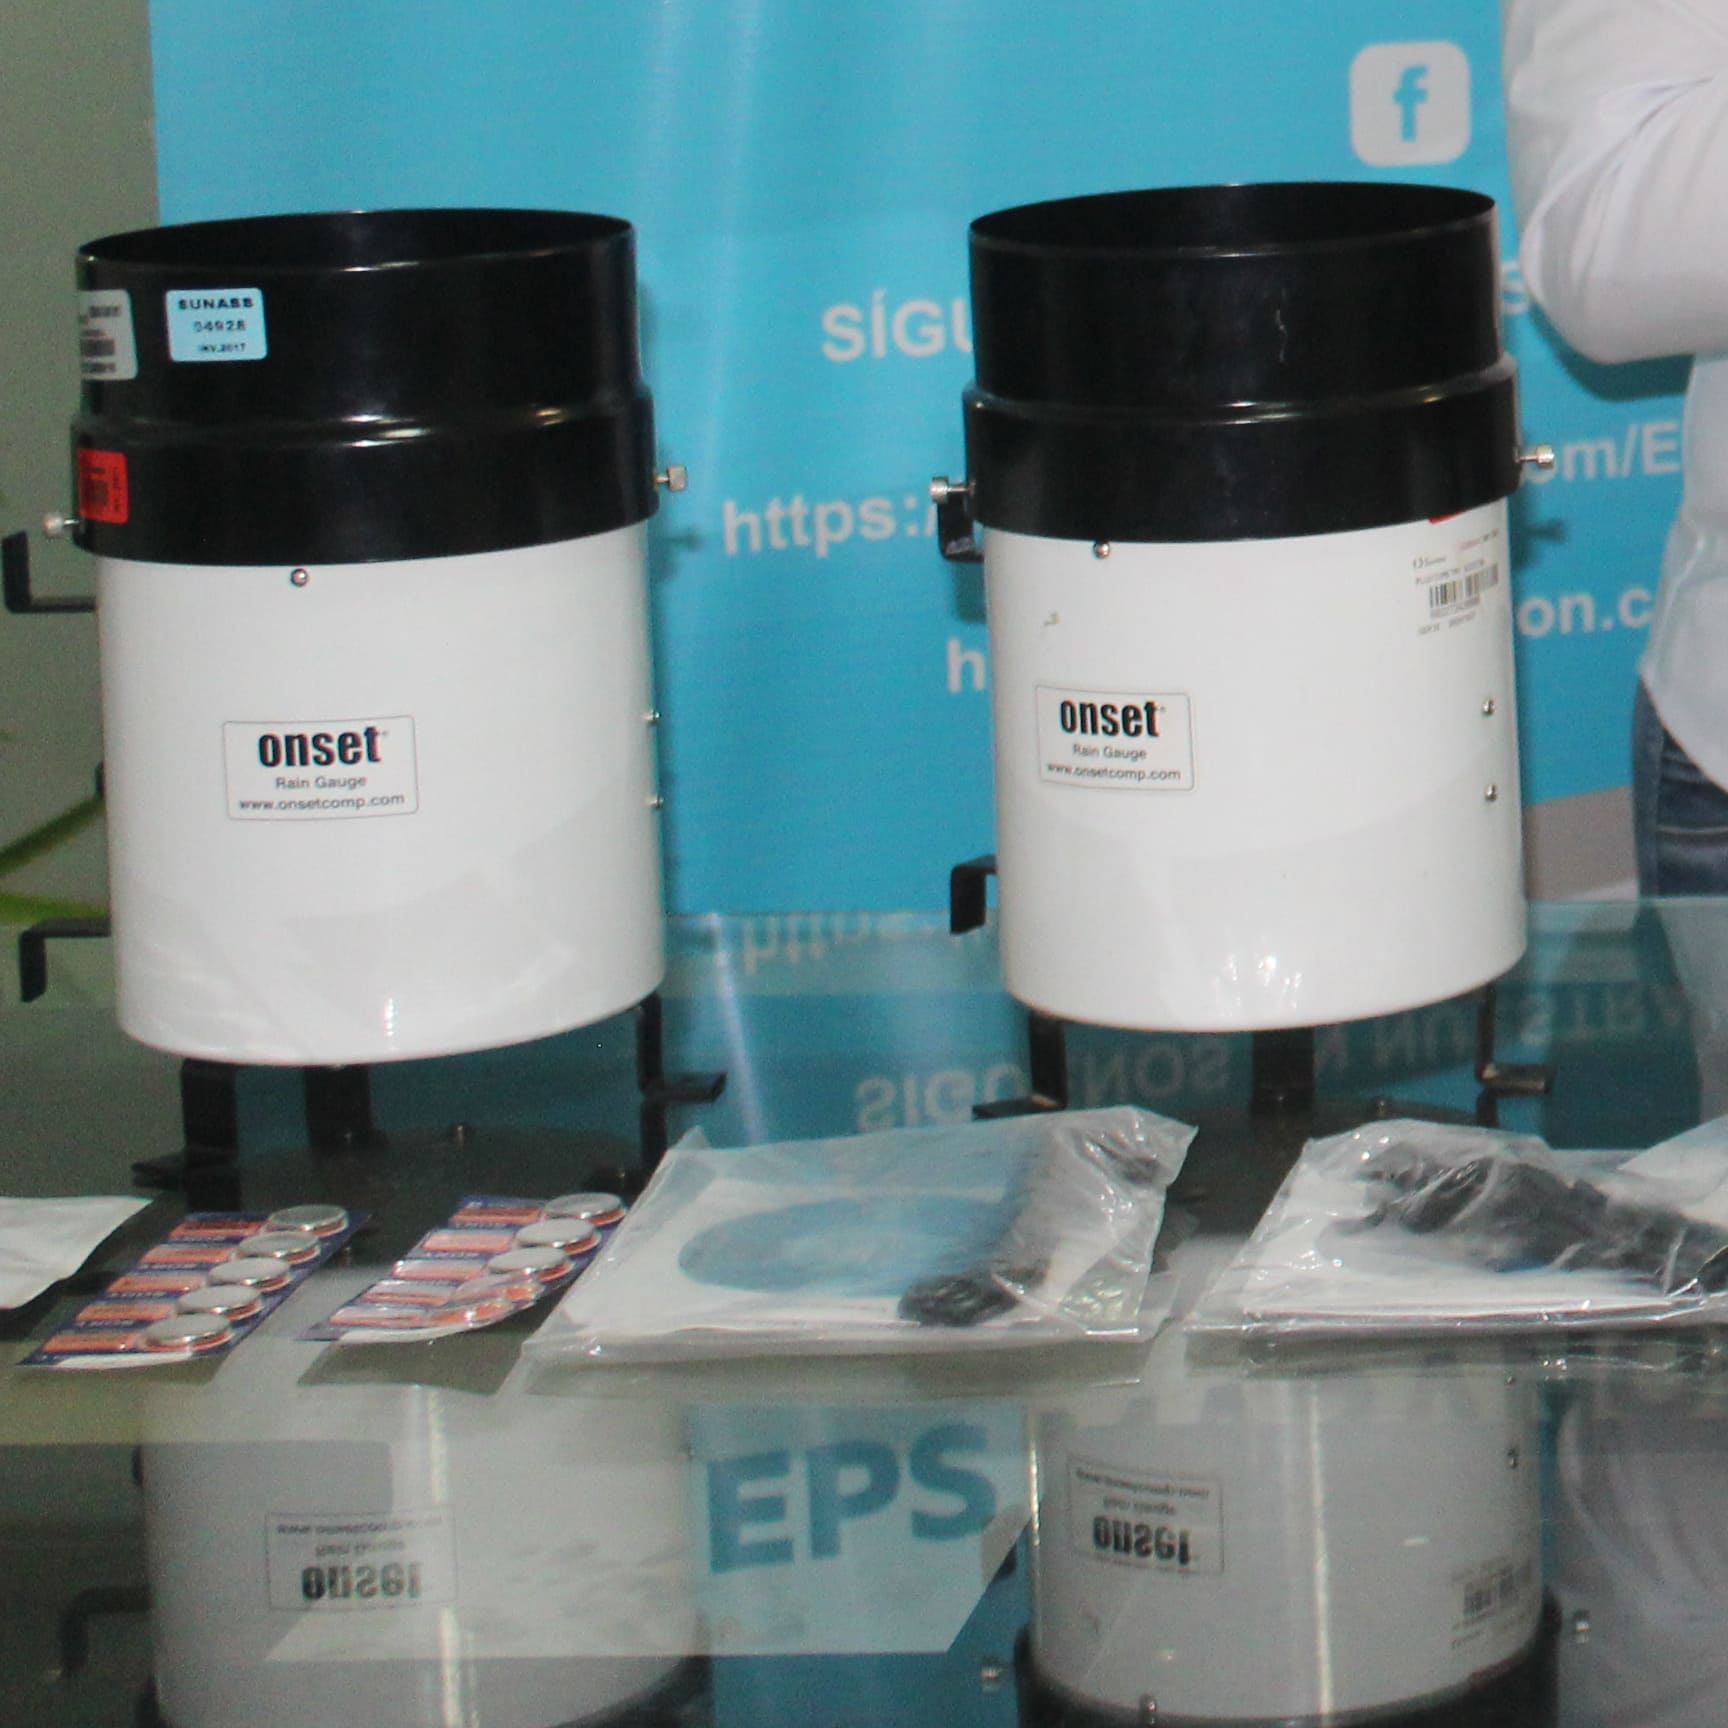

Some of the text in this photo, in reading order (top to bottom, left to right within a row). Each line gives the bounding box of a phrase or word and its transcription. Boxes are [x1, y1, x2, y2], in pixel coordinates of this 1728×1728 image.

[178, 297, 255, 311] SUNASS
[1060, 698, 1160, 738] onset
[259, 725, 382, 768] onset
[1072, 743, 1148, 762] Rain Gauge
[1046, 762, 1182, 782] www.onsetcomp.com
[274, 775, 368, 791] Rain Gauge
[239, 793, 406, 812] www.onsetcomp.com
[706, 1422, 996, 1574] EPS
